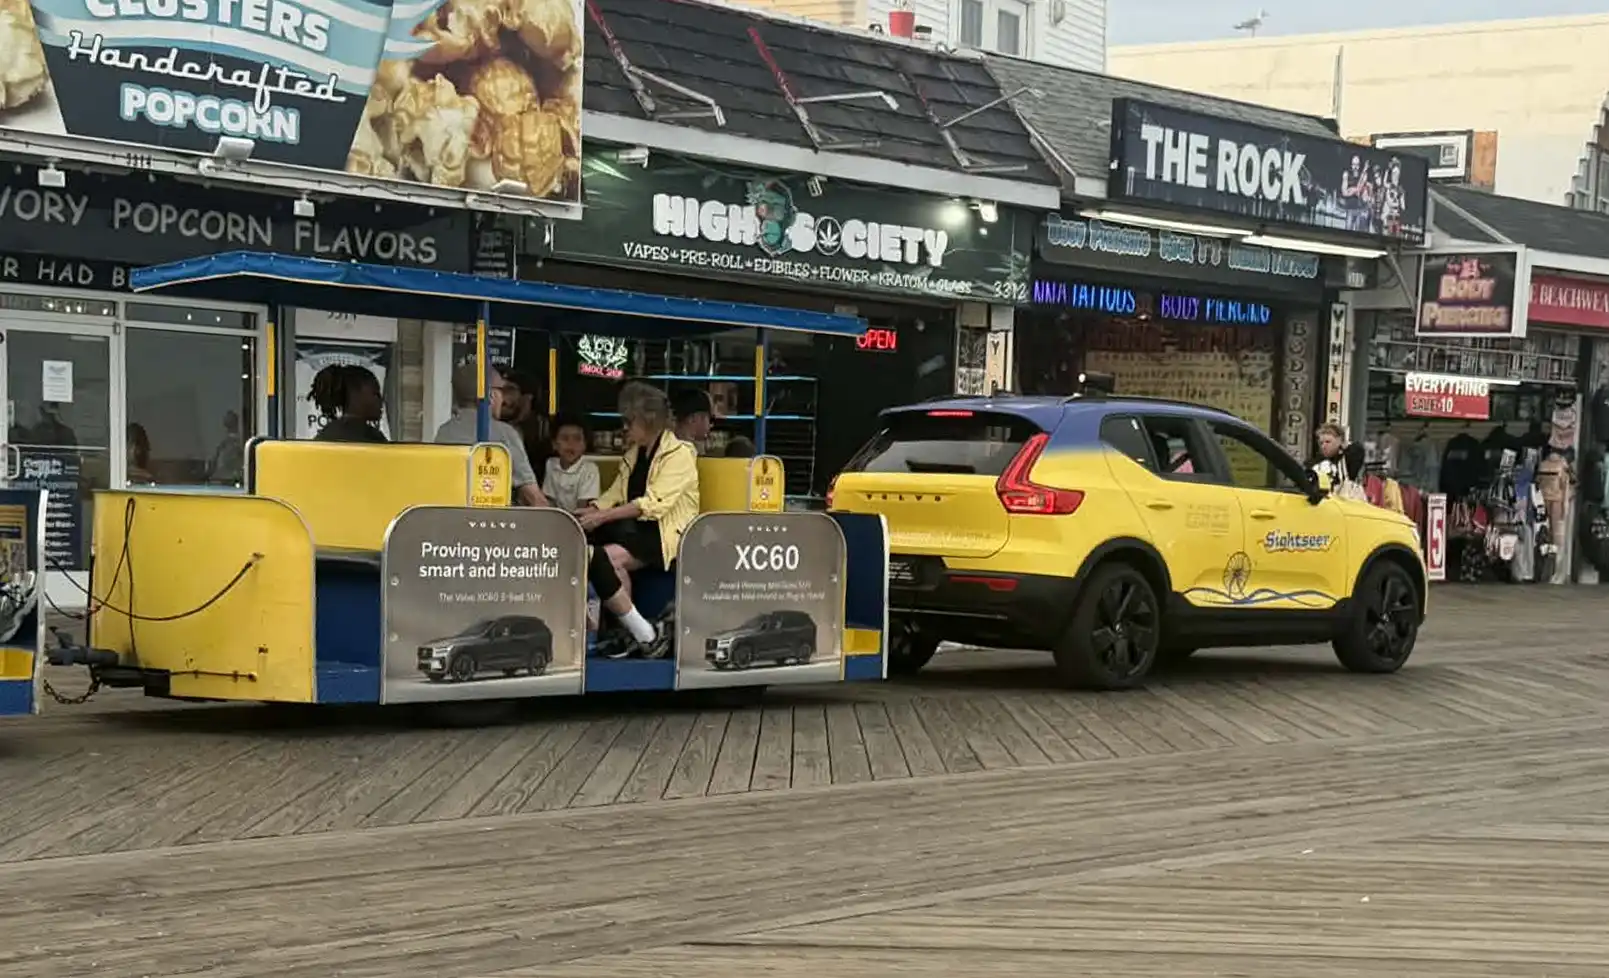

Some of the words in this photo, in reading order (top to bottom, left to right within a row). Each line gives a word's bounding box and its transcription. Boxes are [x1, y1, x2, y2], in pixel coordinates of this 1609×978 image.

[85, 0, 329, 51] CLUSTERS
[68, 31, 345, 113] Handcrafted
[122, 85, 299, 141] POPCORN
[1141, 123, 1209, 188] THE
[1216, 139, 1306, 204] ROCK
[114, 198, 272, 247] POPCORN
[295, 220, 436, 264] FLAVORS
[653, 193, 761, 246] HIGH
[38, 259, 94, 285] HAD
[623, 242, 669, 261] VAPES
[680, 248, 744, 270] PRE-ROLL
[820, 264, 870, 282] FLOWER
[878, 271, 928, 289] KRATOM
[856, 328, 897, 349] OPEN
[1405, 373, 1489, 397] EVERYTHING
[866, 493, 942, 503] VOLVO
[468, 521, 517, 530] VOLVO
[421, 542, 481, 561] Proving
[485, 547, 510, 561] you
[514, 547, 538, 559] can
[542, 544, 559, 560] be
[735, 544, 800, 571] XC60
[419, 562, 465, 578] smart
[469, 563, 496, 578] and
[500, 562, 559, 578] beautiful
